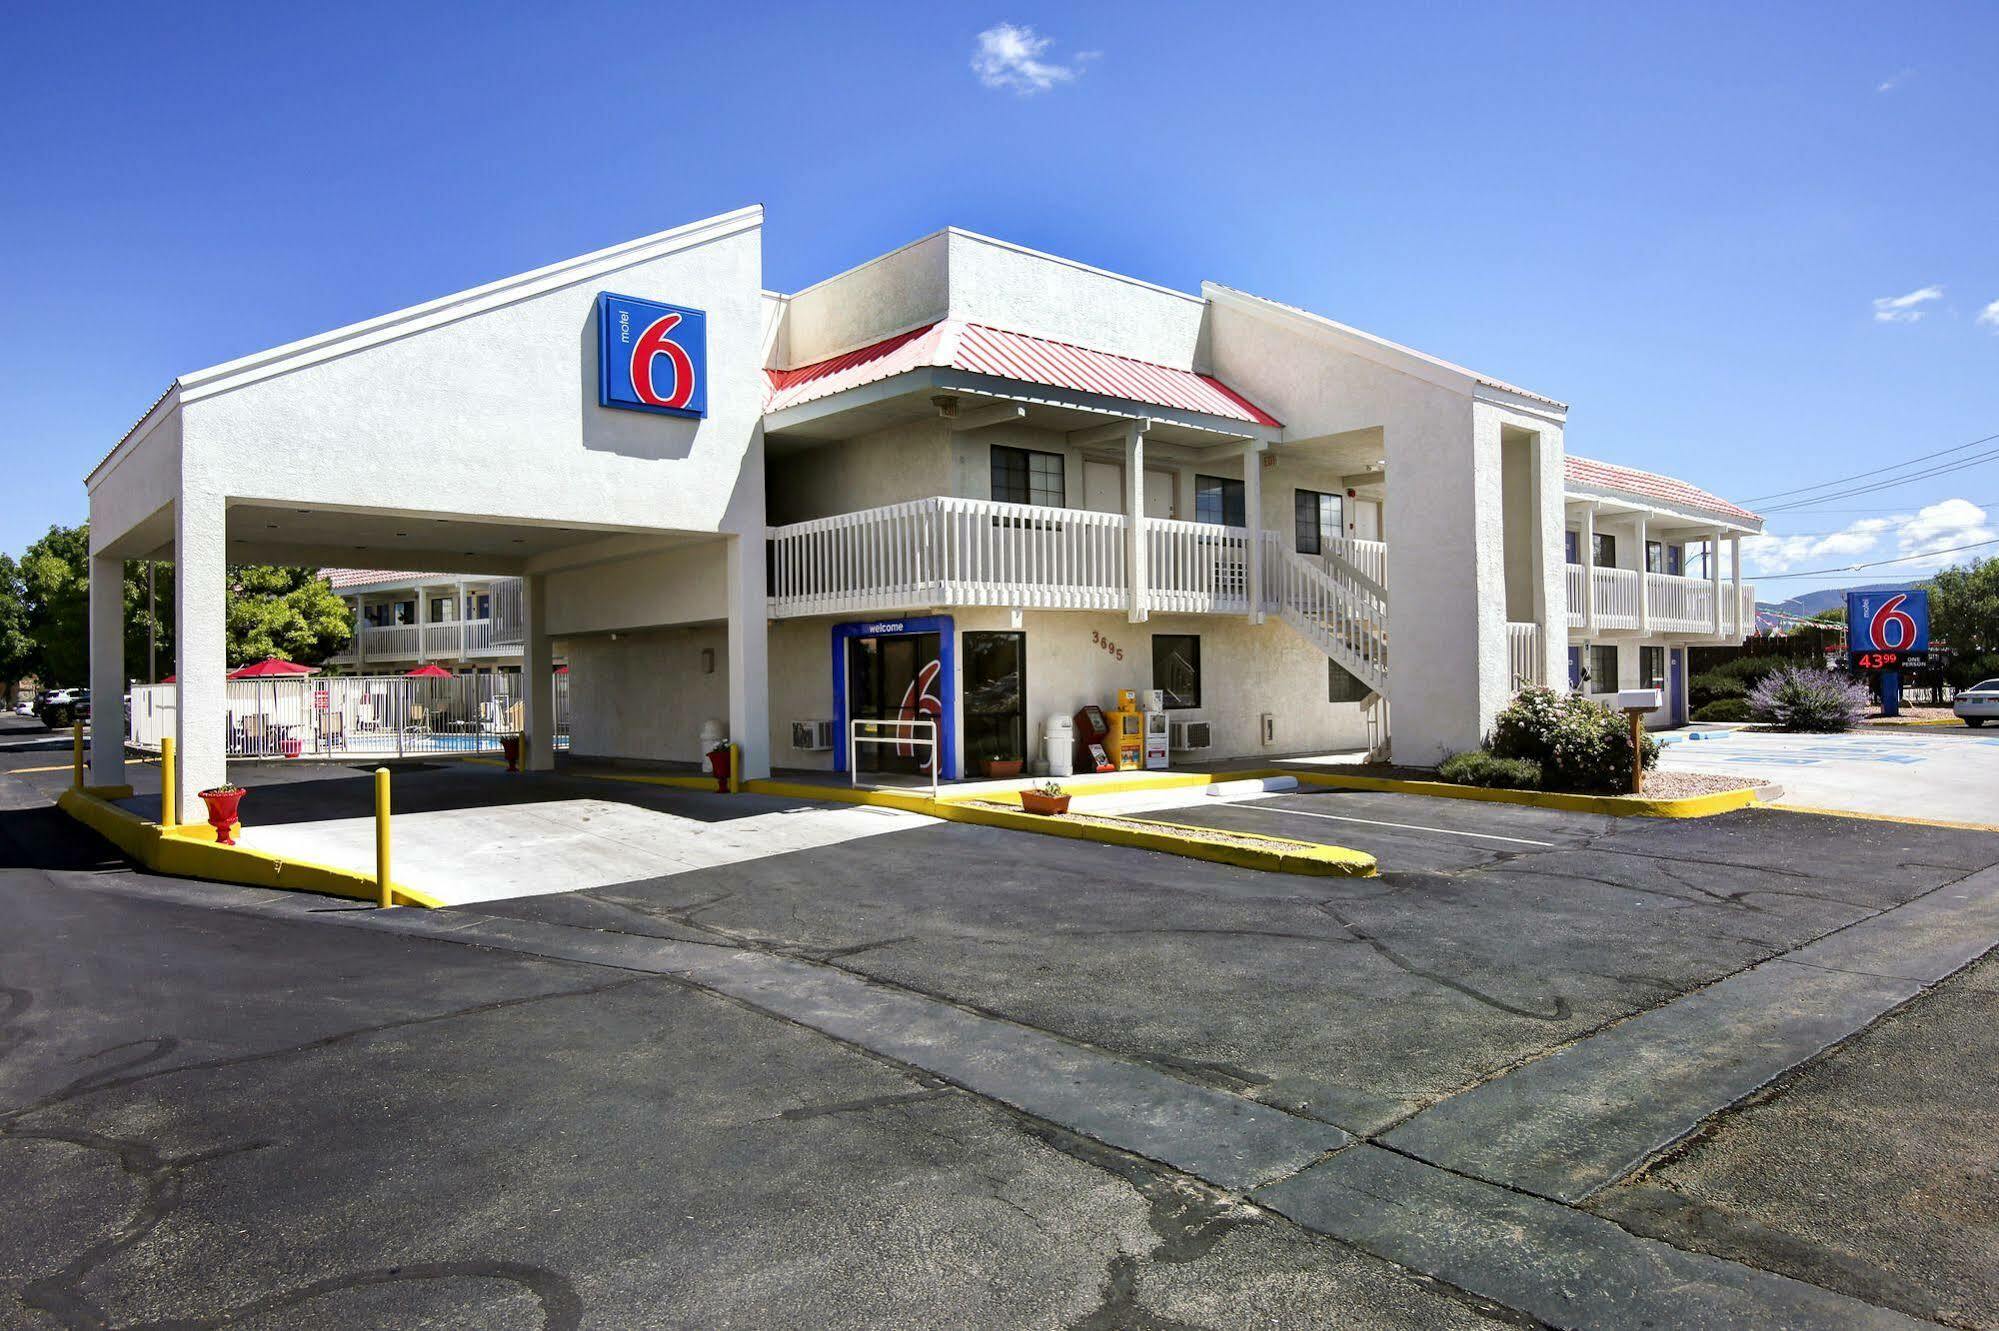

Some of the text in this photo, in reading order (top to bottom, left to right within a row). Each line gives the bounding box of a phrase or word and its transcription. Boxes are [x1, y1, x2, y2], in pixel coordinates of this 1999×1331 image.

[618, 310, 696, 409] motel 6
[869, 622, 904, 634] welcome
[1869, 593, 1916, 650] 6
[1092, 631, 1123, 661] 3695
